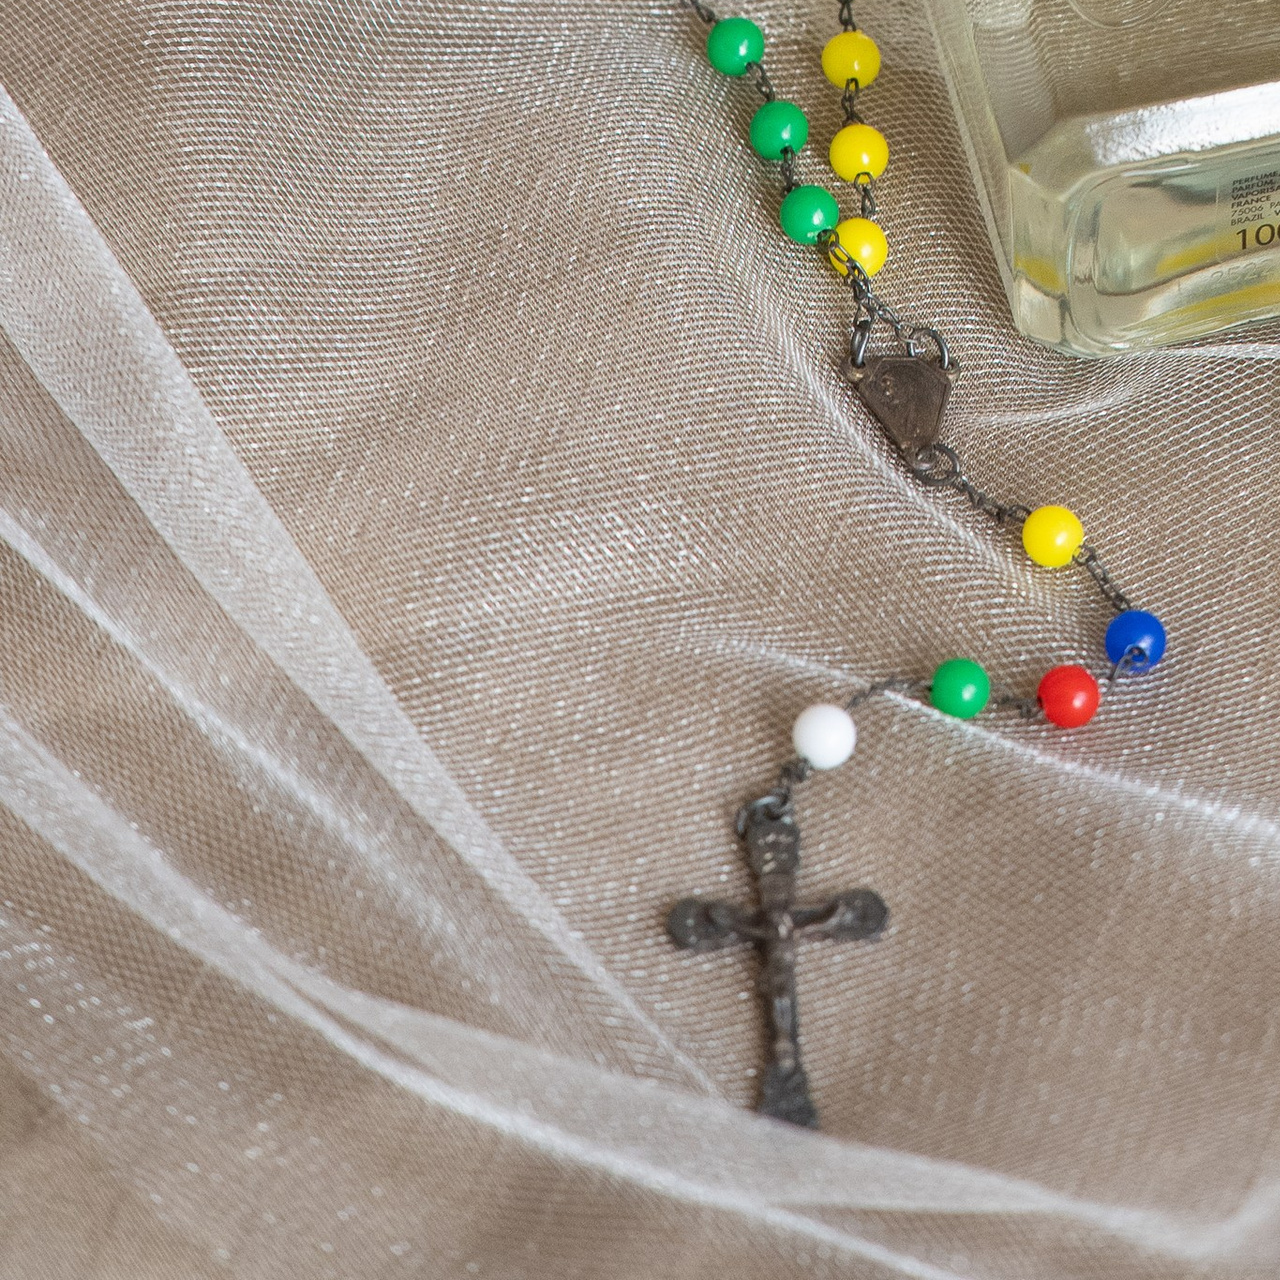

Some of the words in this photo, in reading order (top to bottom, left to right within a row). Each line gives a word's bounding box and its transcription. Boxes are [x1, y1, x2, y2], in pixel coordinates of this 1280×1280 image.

[1231, 194, 1272, 209] FRANCE
[1231, 205, 1264, 218] 75006
[1230, 213, 1265, 226] BRAZIL
